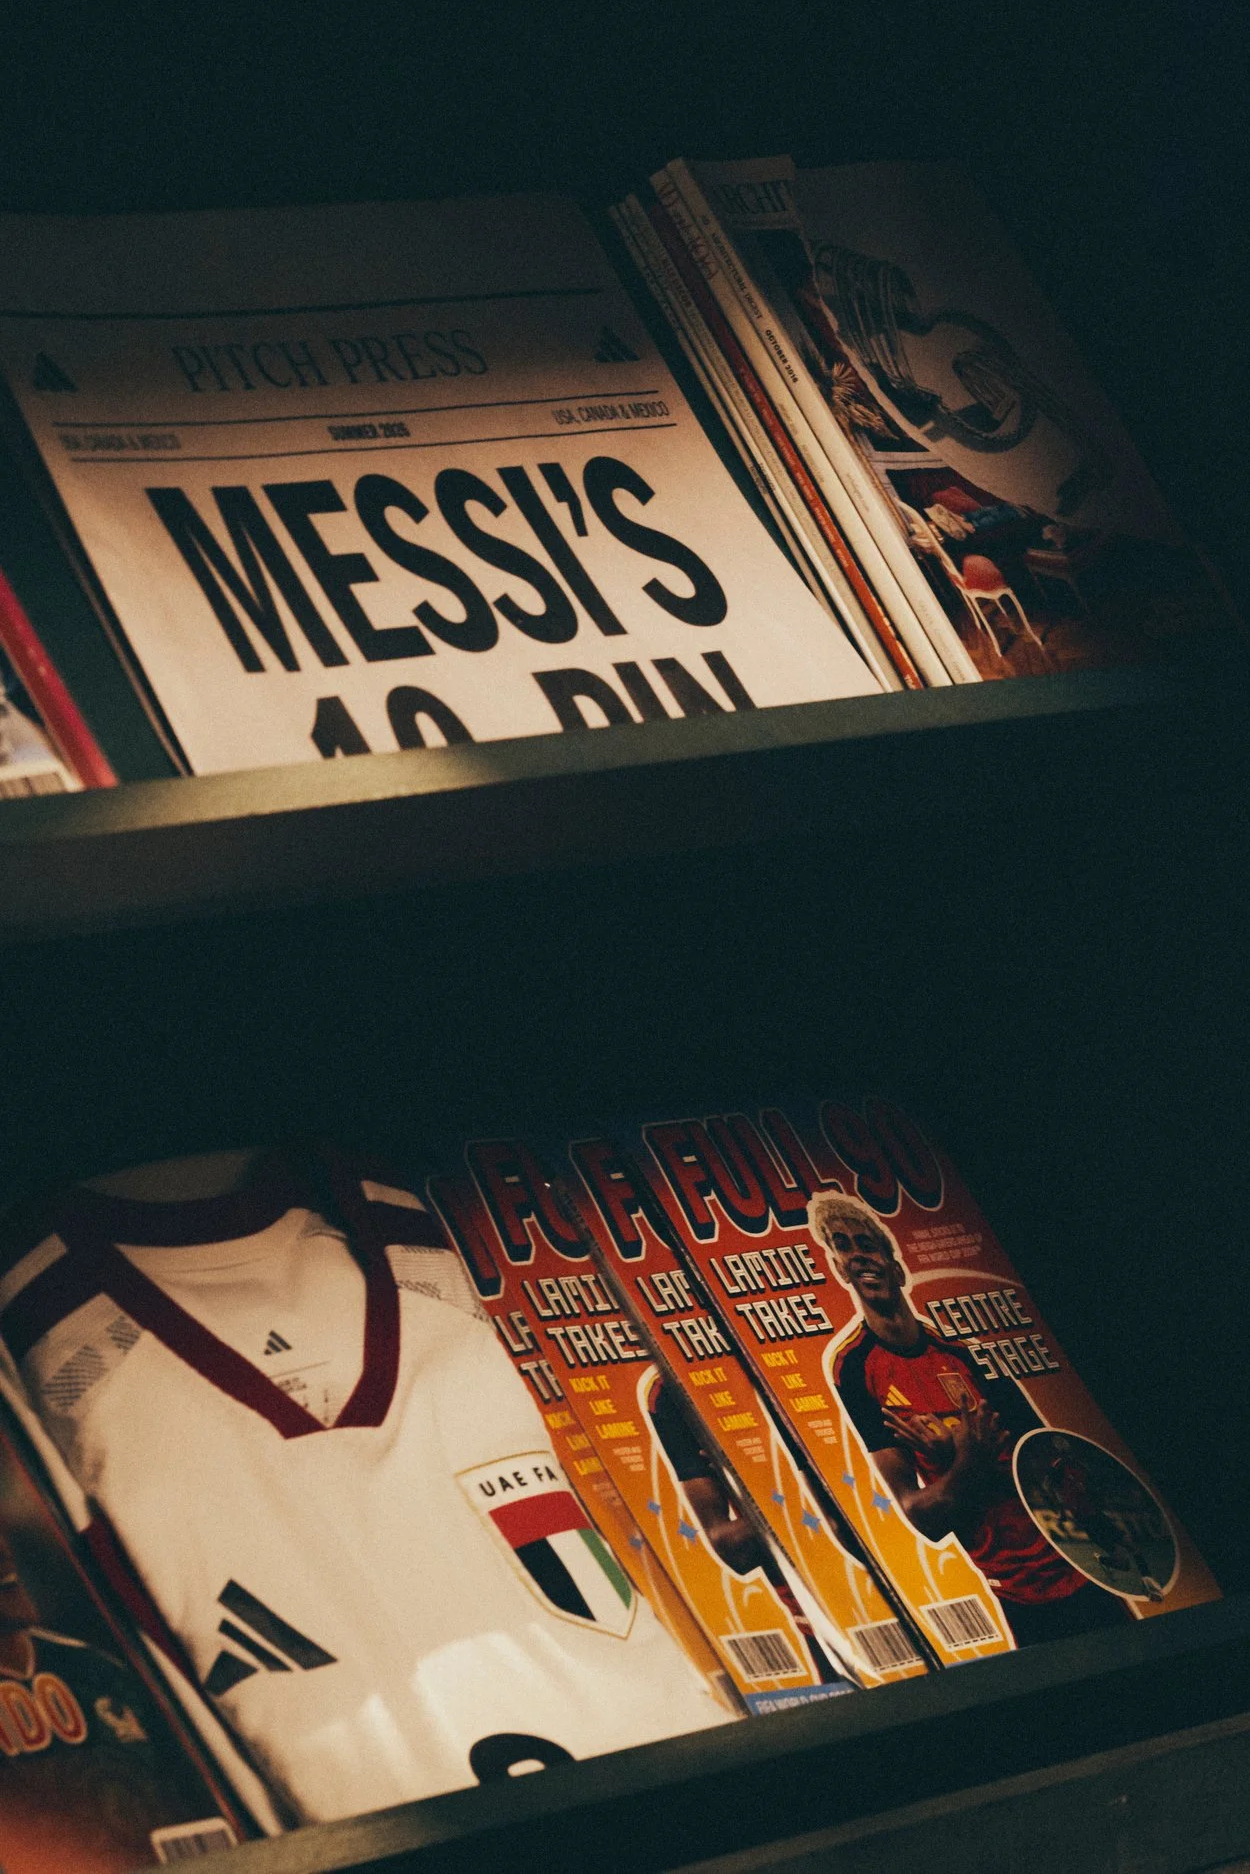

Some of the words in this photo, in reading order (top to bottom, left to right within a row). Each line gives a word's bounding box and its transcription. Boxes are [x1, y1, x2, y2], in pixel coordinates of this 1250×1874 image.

[765, 329, 788, 365] OCTOBER
[172, 340, 330, 392] PITCH
[327, 329, 489, 384] PRESS
[628, 400, 671, 419] MEXICO
[145, 455, 728, 673] MESSI'S
[642, 1108, 844, 1243] FULL
[819, 1097, 945, 1218] 90
[709, 1243, 826, 1298] LAMINE
[735, 1292, 834, 1344] TAKES
[926, 1288, 1033, 1341] CENTRE
[760, 1349, 785, 1368] KICK
[784, 1349, 799, 1366] IT
[968, 1333, 1060, 1381] STAGE
[568, 1376, 598, 1394] KICK
[595, 1374, 611, 1391] IT
[688, 1368, 716, 1387] KICK
[714, 1366, 729, 1384] IT
[781, 1372, 808, 1390] LIKE
[588, 1398, 617, 1416] LIKE
[708, 1389, 737, 1408] LIKE
[789, 1393, 830, 1414] LAMINE
[595, 1420, 640, 1440] LAMINE
[716, 1411, 759, 1433] LAMINE
[479, 1471, 528, 1497] UAE
[533, 1465, 559, 1482] FA
